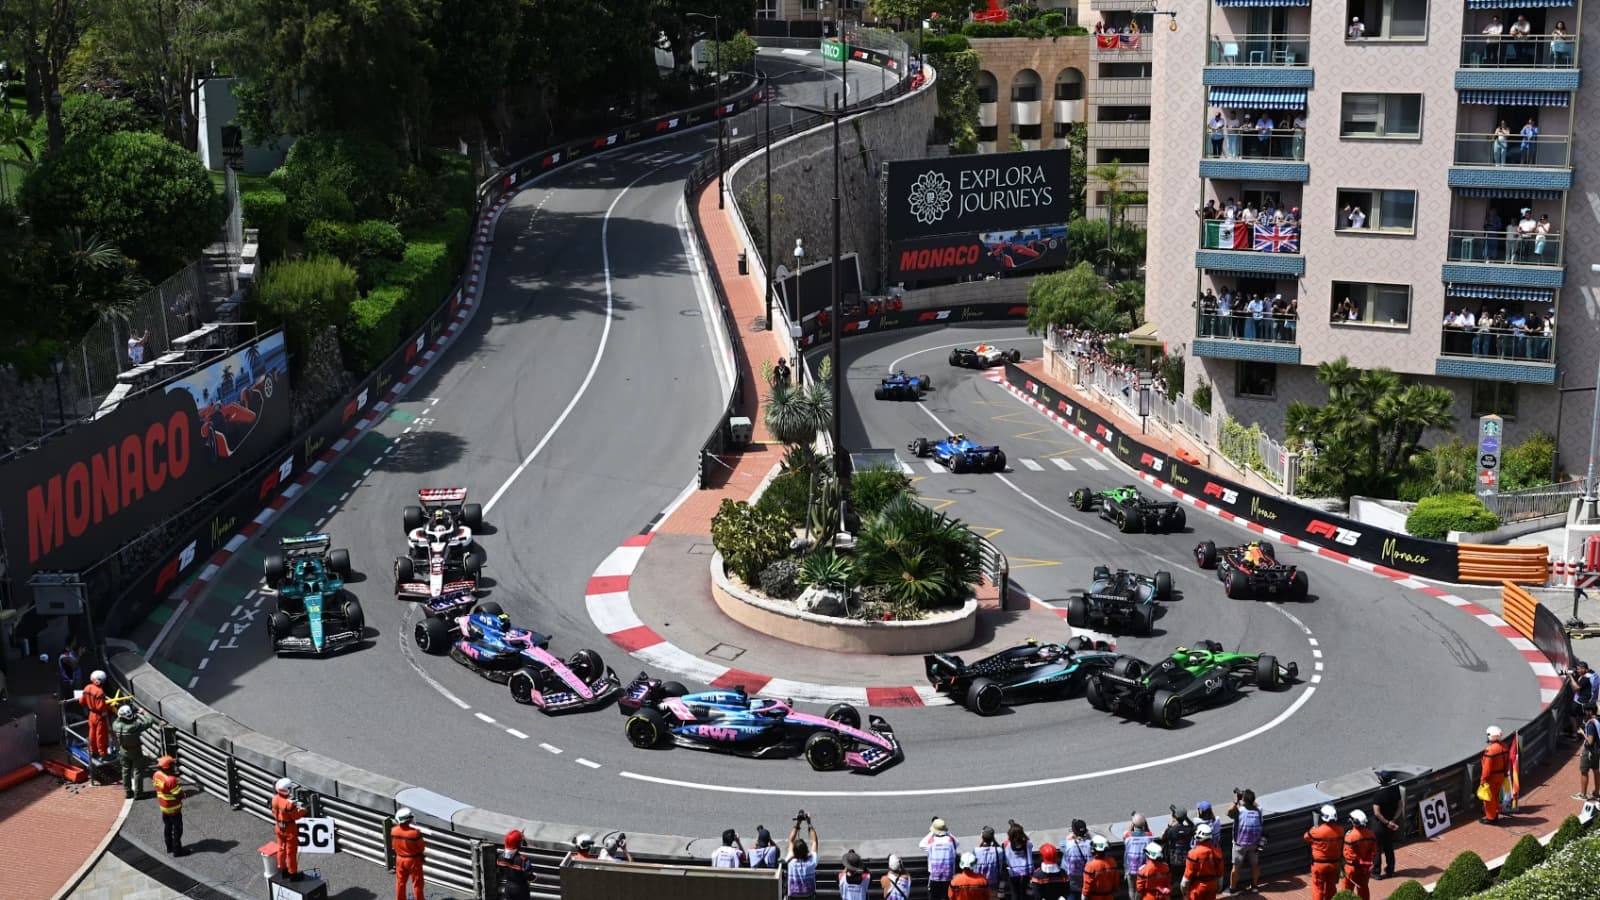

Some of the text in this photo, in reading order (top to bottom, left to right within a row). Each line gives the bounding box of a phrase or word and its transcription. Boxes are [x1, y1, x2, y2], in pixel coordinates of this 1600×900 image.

[960, 165, 1046, 190] EXPLORA
[957, 186, 1053, 219] JOURNEYS
[900, 245, 980, 271] MONACO
[27, 410, 190, 563] MONACO
[1250, 496, 1278, 521] Monaco
[1381, 537, 1430, 566] Monaco
[1424, 799, 1447, 830] SC
[298, 823, 329, 848] SC
